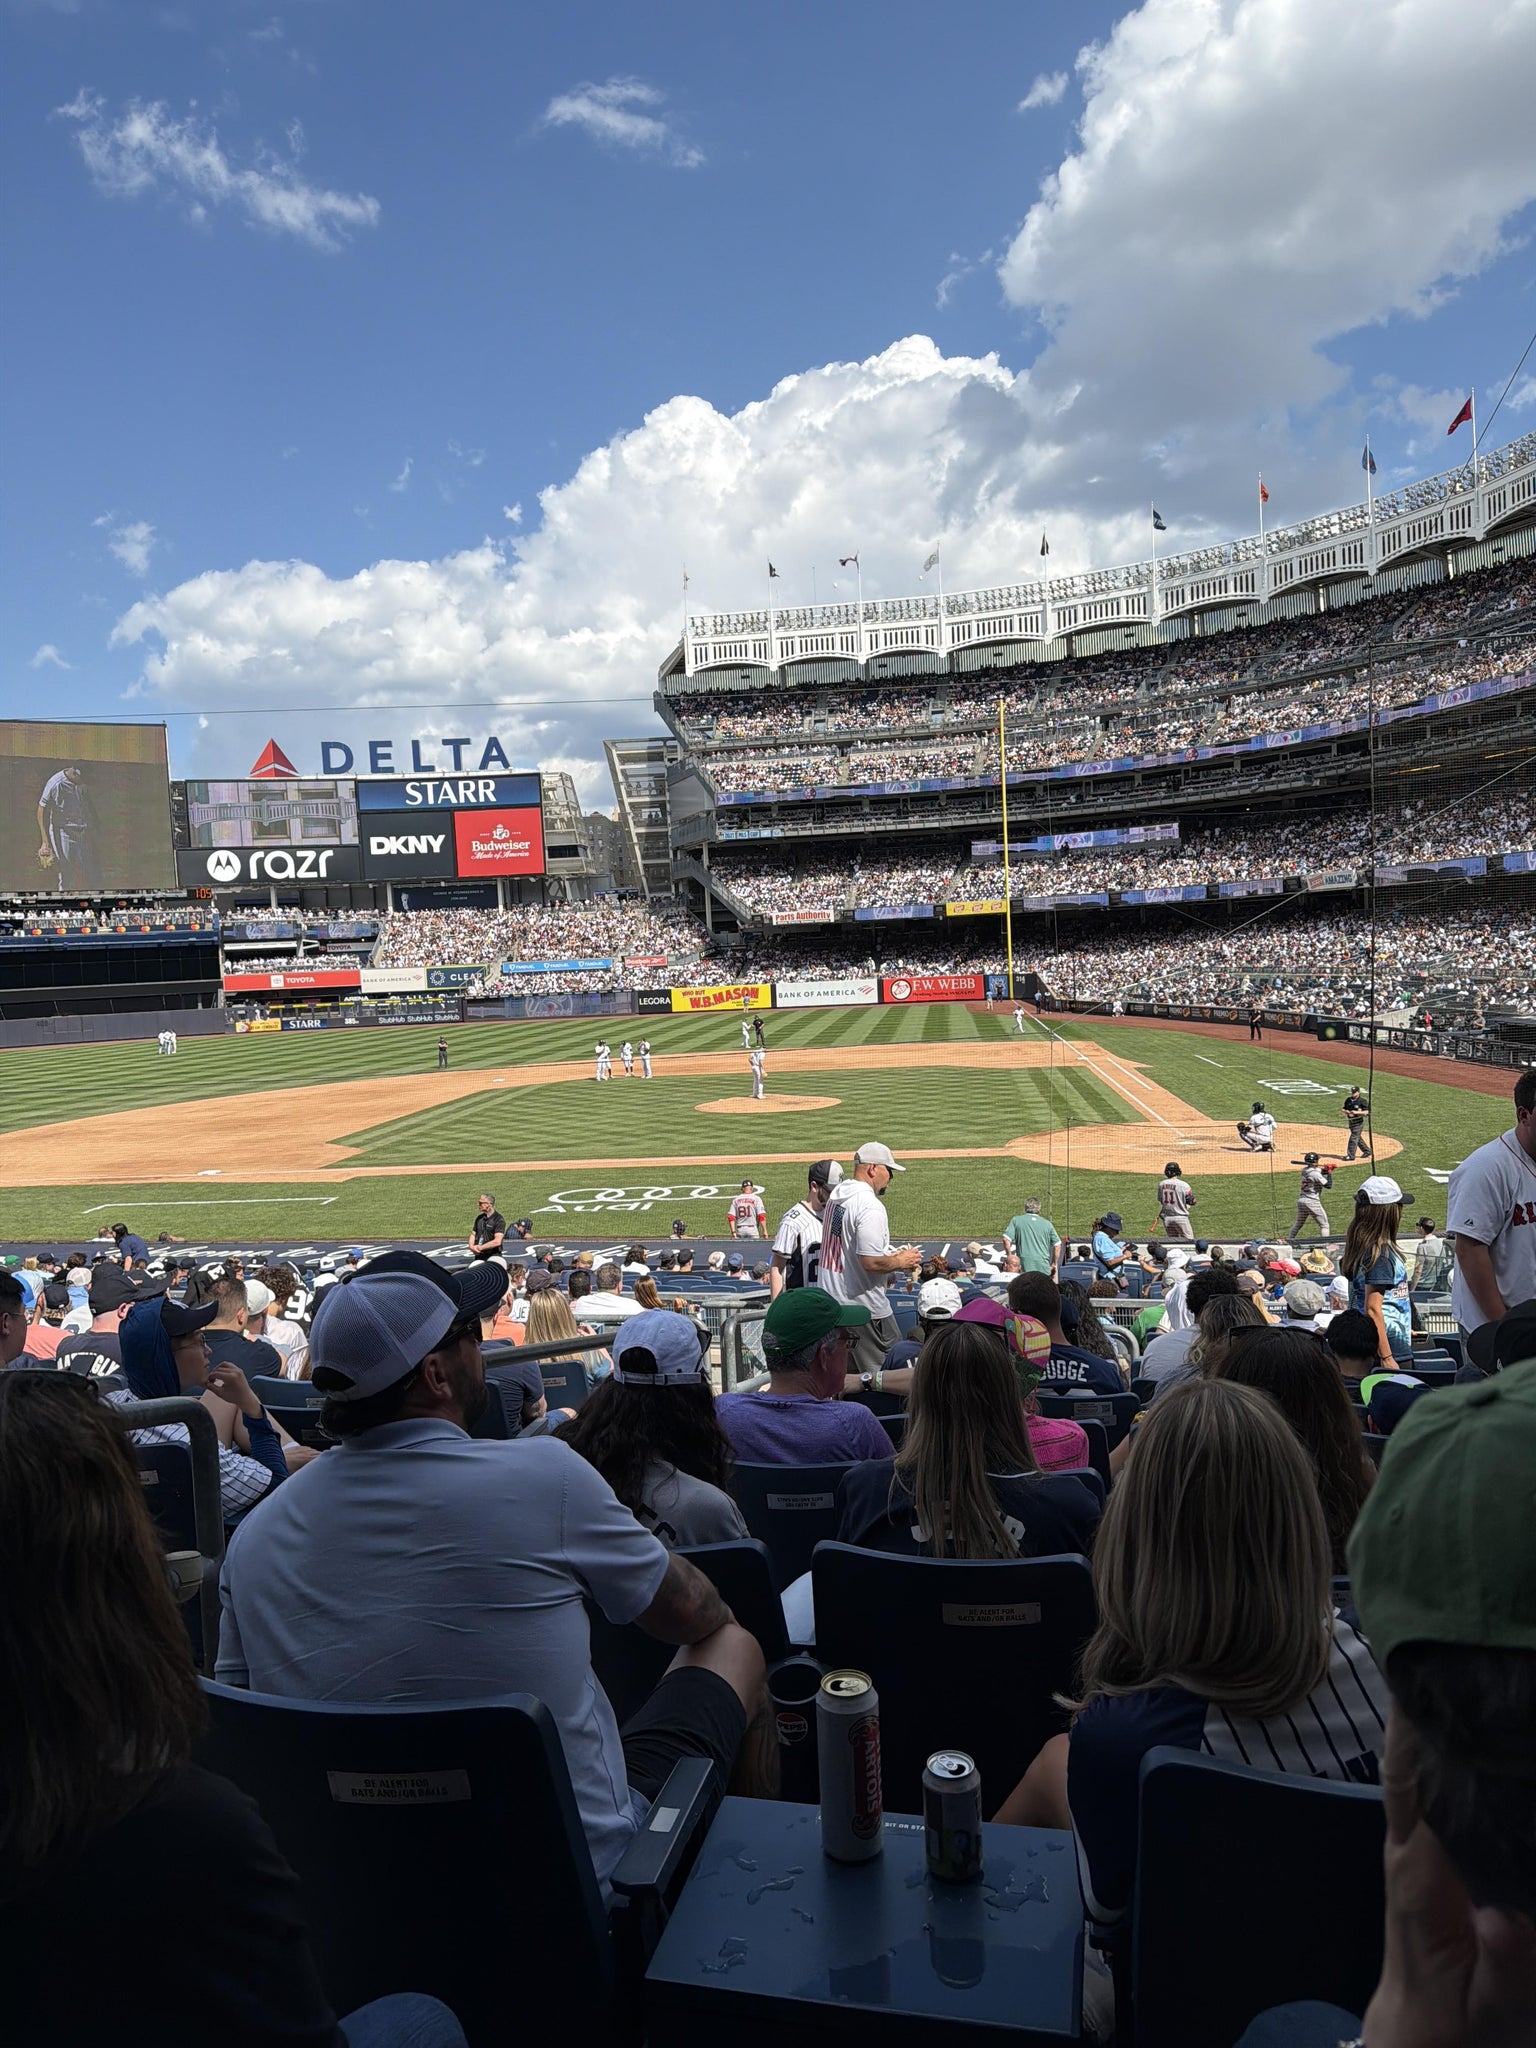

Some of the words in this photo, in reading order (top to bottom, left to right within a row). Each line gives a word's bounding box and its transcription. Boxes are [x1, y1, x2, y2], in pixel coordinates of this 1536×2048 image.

[321, 736, 511, 775] DELTA
[405, 779, 497, 806] STARR
[369, 834, 446, 855] DKNY
[471, 840, 531, 852] Budweiser
[249, 849, 334, 880] razr
[775, 913, 795, 921] Parts
[796, 910, 831, 921] Authority
[285, 976, 316, 984] TOYOTA
[912, 979, 935, 991] F.W.
[938, 977, 976, 990] WEBB
[804, 990, 814, 998] OF
[816, 989, 856, 997] AMERICA
[639, 996, 671, 1006] LEGORA
[378, 1014, 406, 1024] StubHub
[406, 1013, 433, 1024] StubHub
[434, 1013, 460, 1022] StubHub
[289, 1019, 321, 1029] STARR
[529, 1201, 655, 1214] Audi
[737, 1205, 752, 1219] 81
[777, 1721, 807, 1731] PEPSI
[864, 1740, 879, 1814] ARTOIS
[380, 1780, 407, 1788] ALERT
